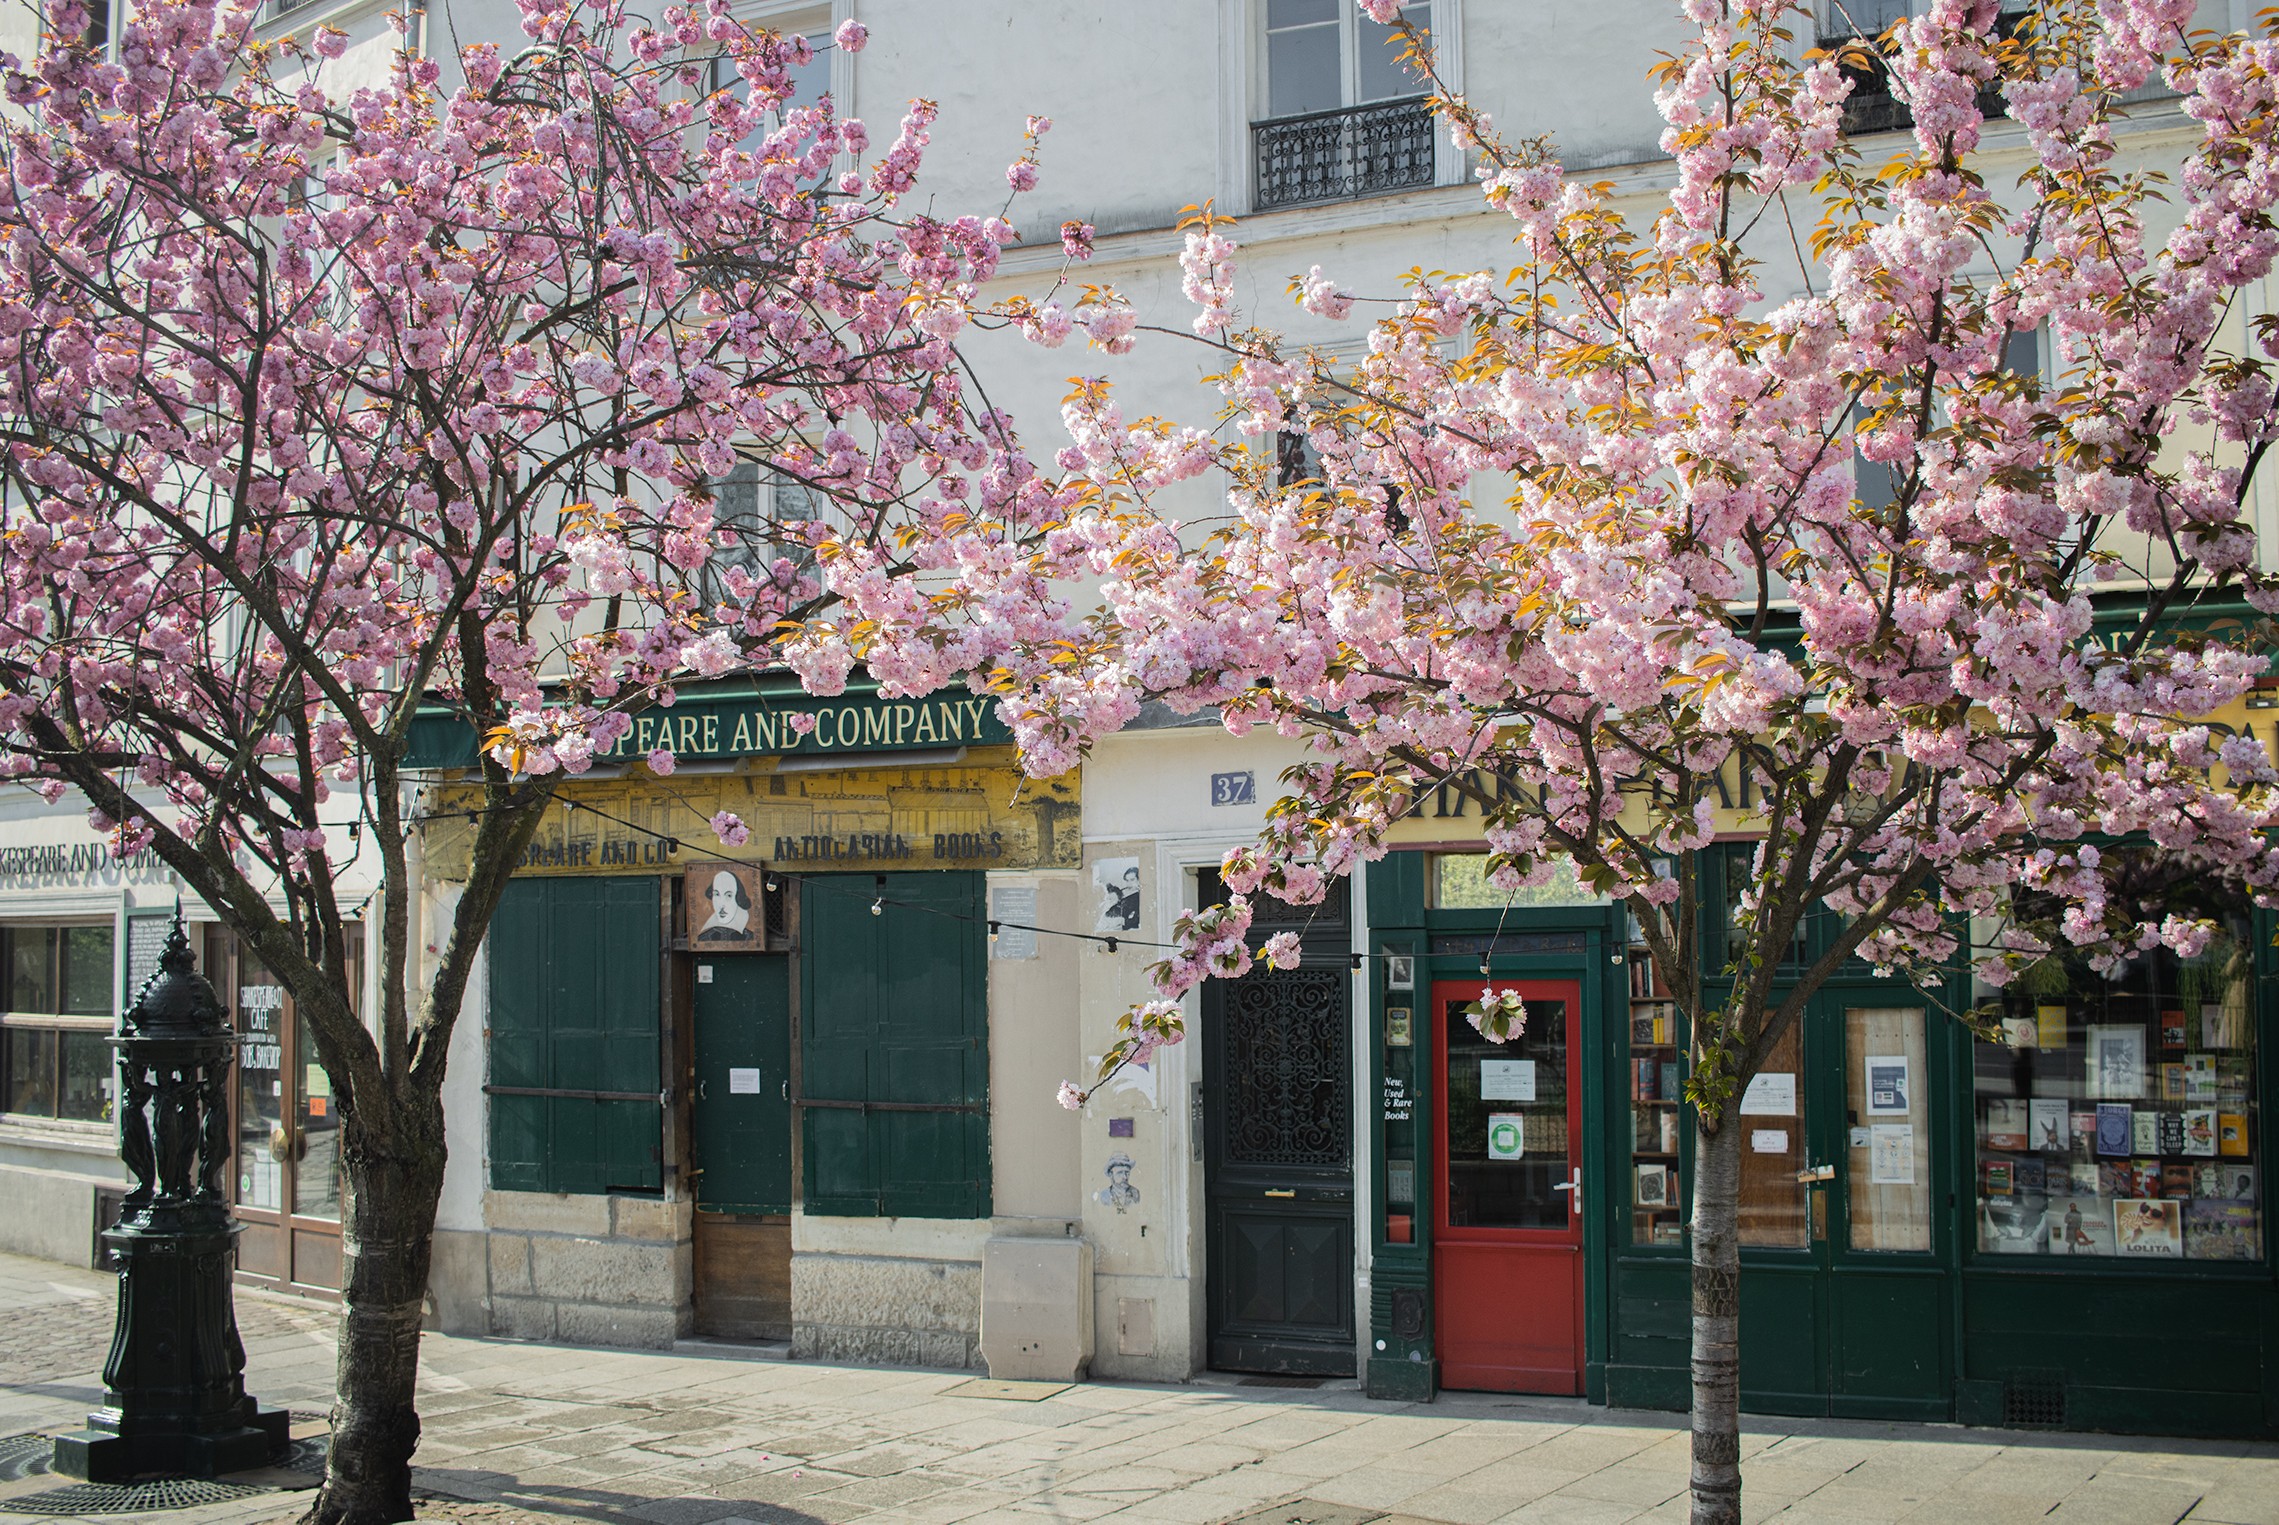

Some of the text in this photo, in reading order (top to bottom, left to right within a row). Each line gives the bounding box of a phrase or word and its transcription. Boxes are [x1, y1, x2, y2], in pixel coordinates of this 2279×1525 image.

[597, 699, 988, 756] PEARE AND COMPANY
[1217, 776, 1248, 802] 37
[600, 841, 638, 865] AND
[934, 831, 1002, 859] BOOKS
[70, 843, 106, 871] AND
[1384, 1077, 1404, 1088] New,
[1384, 1089, 1404, 1099] Used
[1384, 1098, 1413, 1107] & Rare
[1384, 1110, 1410, 1120] Books
[2127, 1244, 2171, 1253] LOLITA
